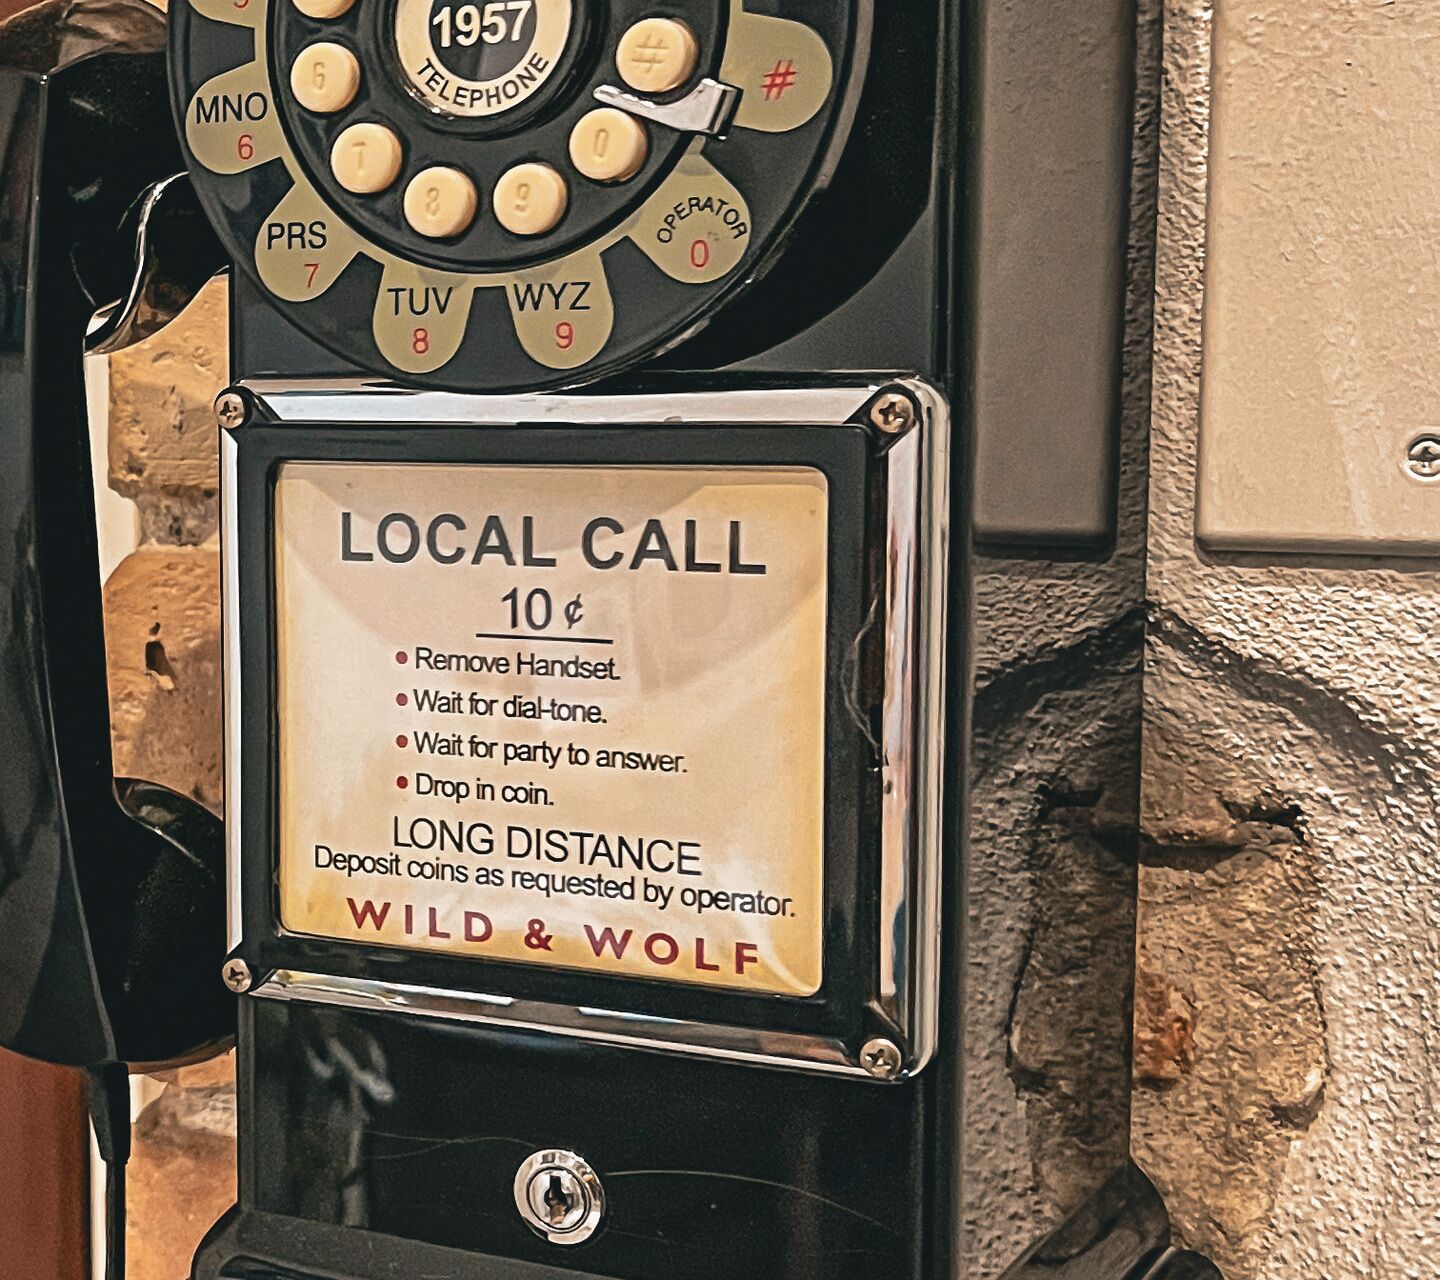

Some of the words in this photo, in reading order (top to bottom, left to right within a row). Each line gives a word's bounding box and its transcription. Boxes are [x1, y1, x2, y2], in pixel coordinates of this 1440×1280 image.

[432, 0, 532, 48] 1957
[416, 51, 550, 109] TELEPHONE
[195, 91, 269, 125] MNO
[237, 134, 254, 161] 6
[266, 220, 328, 251] PRS
[656, 196, 748, 245] OPERATOR
[689, 239, 710, 269] 0
[304, 262, 320, 290] 7
[388, 287, 454, 317] TUV
[513, 281, 592, 313] WYZ
[412, 327, 430, 356] 8
[555, 321, 575, 350] 9
[340, 510, 557, 568] LOCAL
[581, 516, 767, 575] CALL
[501, 586, 553, 631] 10
[415, 646, 510, 675] Remove
[413, 688, 463, 714] Wait
[468, 691, 499, 716] for
[503, 694, 607, 724] dial-tone.
[413, 730, 463, 757] Wait
[468, 733, 499, 759] for
[503, 737, 560, 770] party
[568, 742, 590, 767] to
[595, 748, 688, 773] answer.
[415, 773, 470, 805] Drop
[475, 776, 494, 801] in
[501, 780, 554, 806] coin.
[393, 816, 494, 856] LONG
[507, 827, 702, 876] DISTANCE
[314, 845, 402, 880] Deposit
[406, 857, 469, 884] coins
[475, 867, 504, 887] as
[511, 870, 635, 902] requested
[643, 878, 674, 910] by
[679, 885, 796, 919] operator.
[346, 897, 493, 944] WILD
[523, 918, 554, 951] &
[583, 924, 760, 975] WOLF
